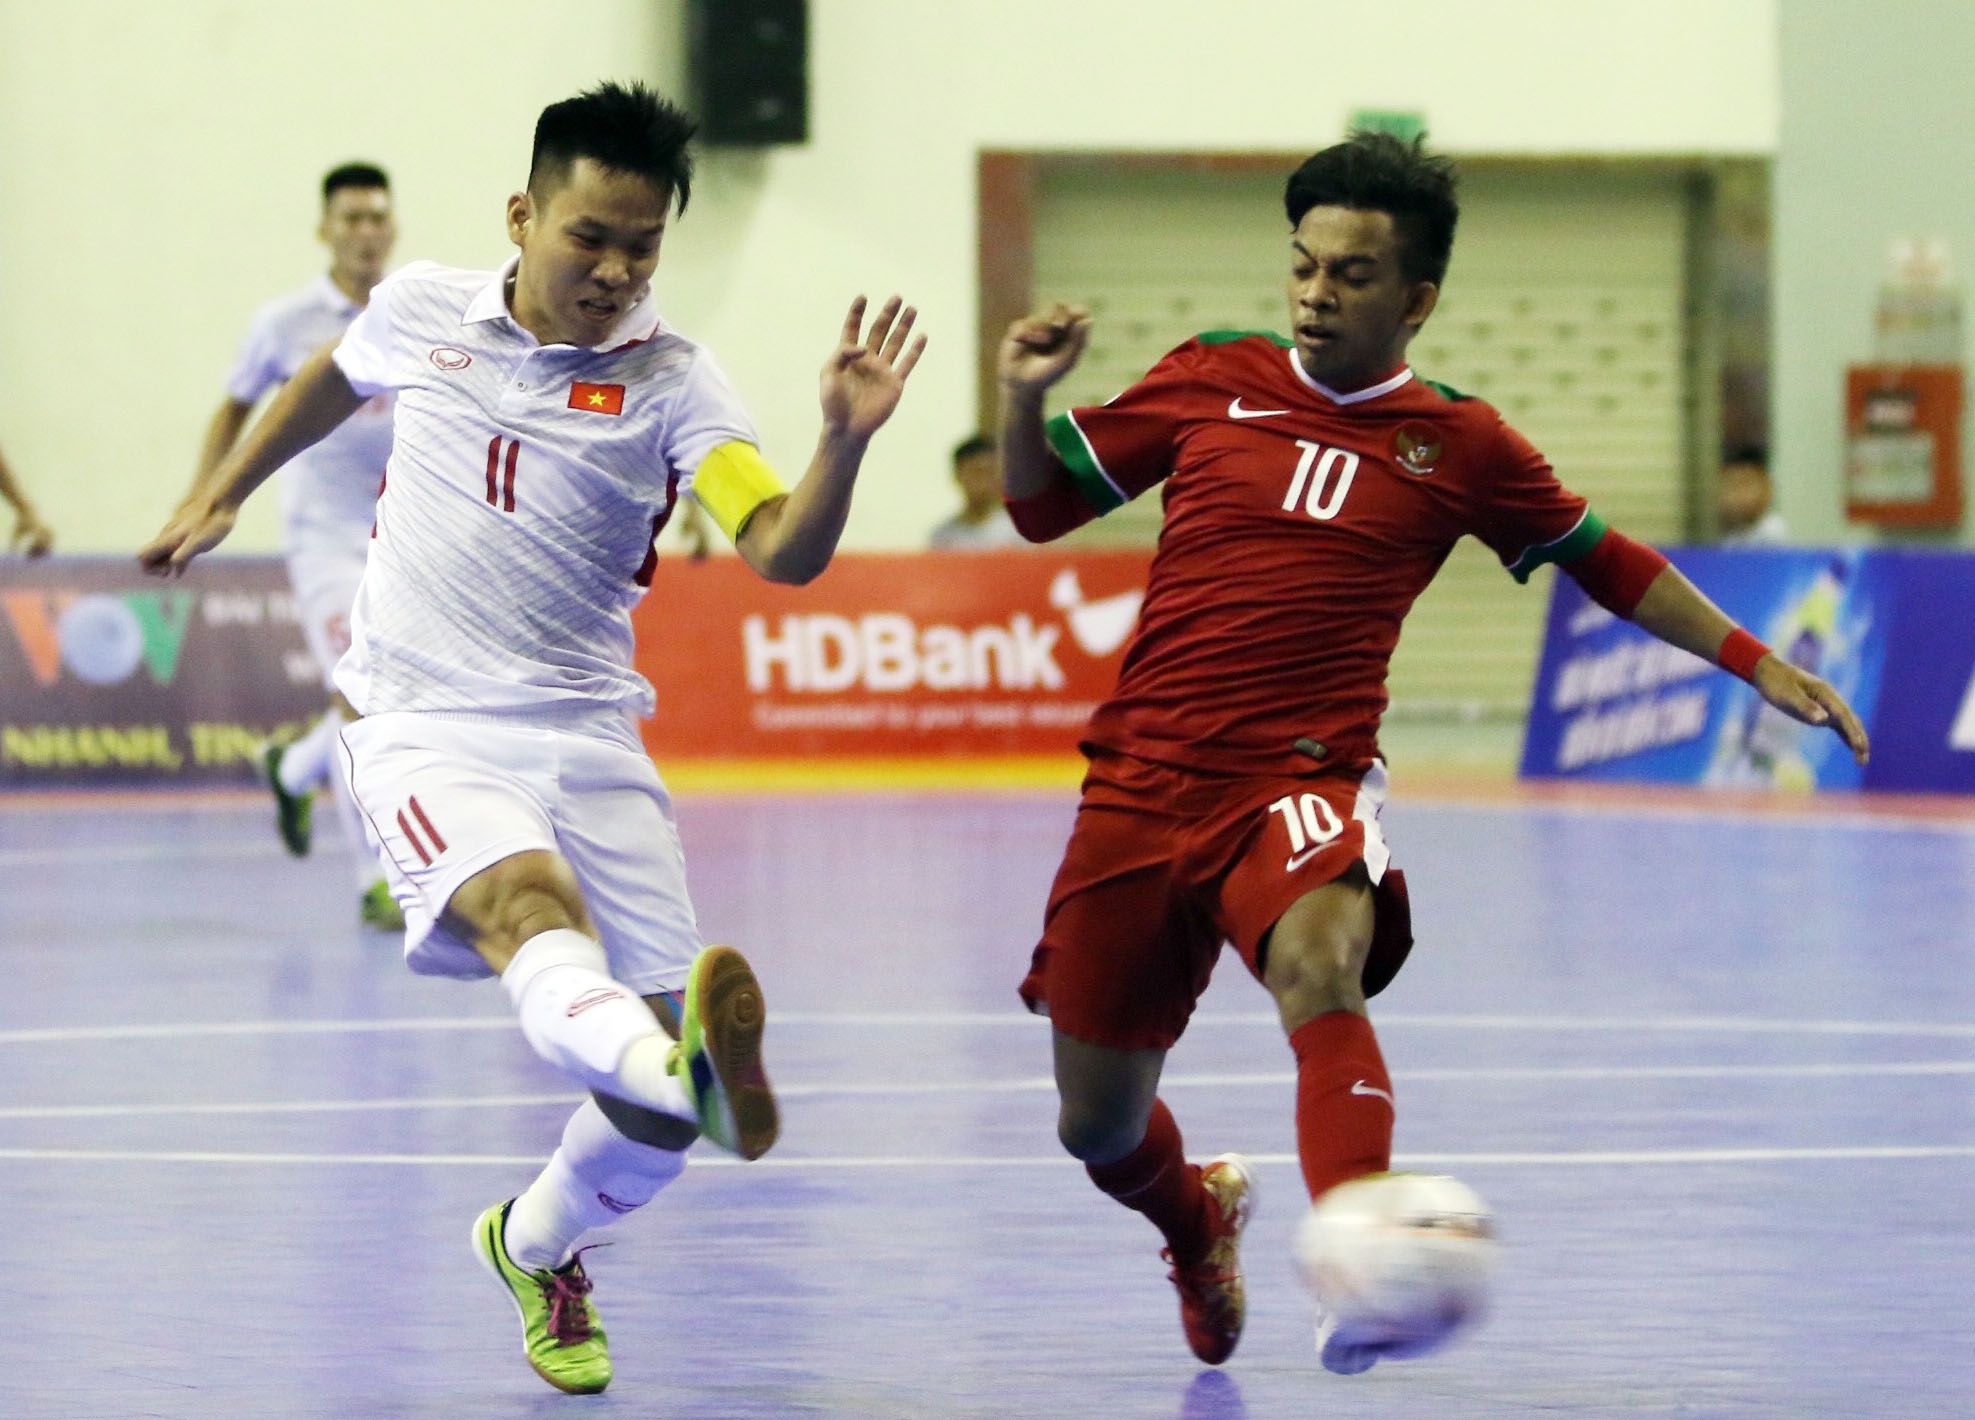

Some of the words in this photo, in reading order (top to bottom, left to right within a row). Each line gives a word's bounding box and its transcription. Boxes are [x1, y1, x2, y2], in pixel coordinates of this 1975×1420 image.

[485, 434, 520, 513] 11
[1281, 439, 1360, 521] 10
[742, 612, 1067, 693] HDBank
[397, 794, 448, 868] 11
[1268, 793, 1344, 853] 10
